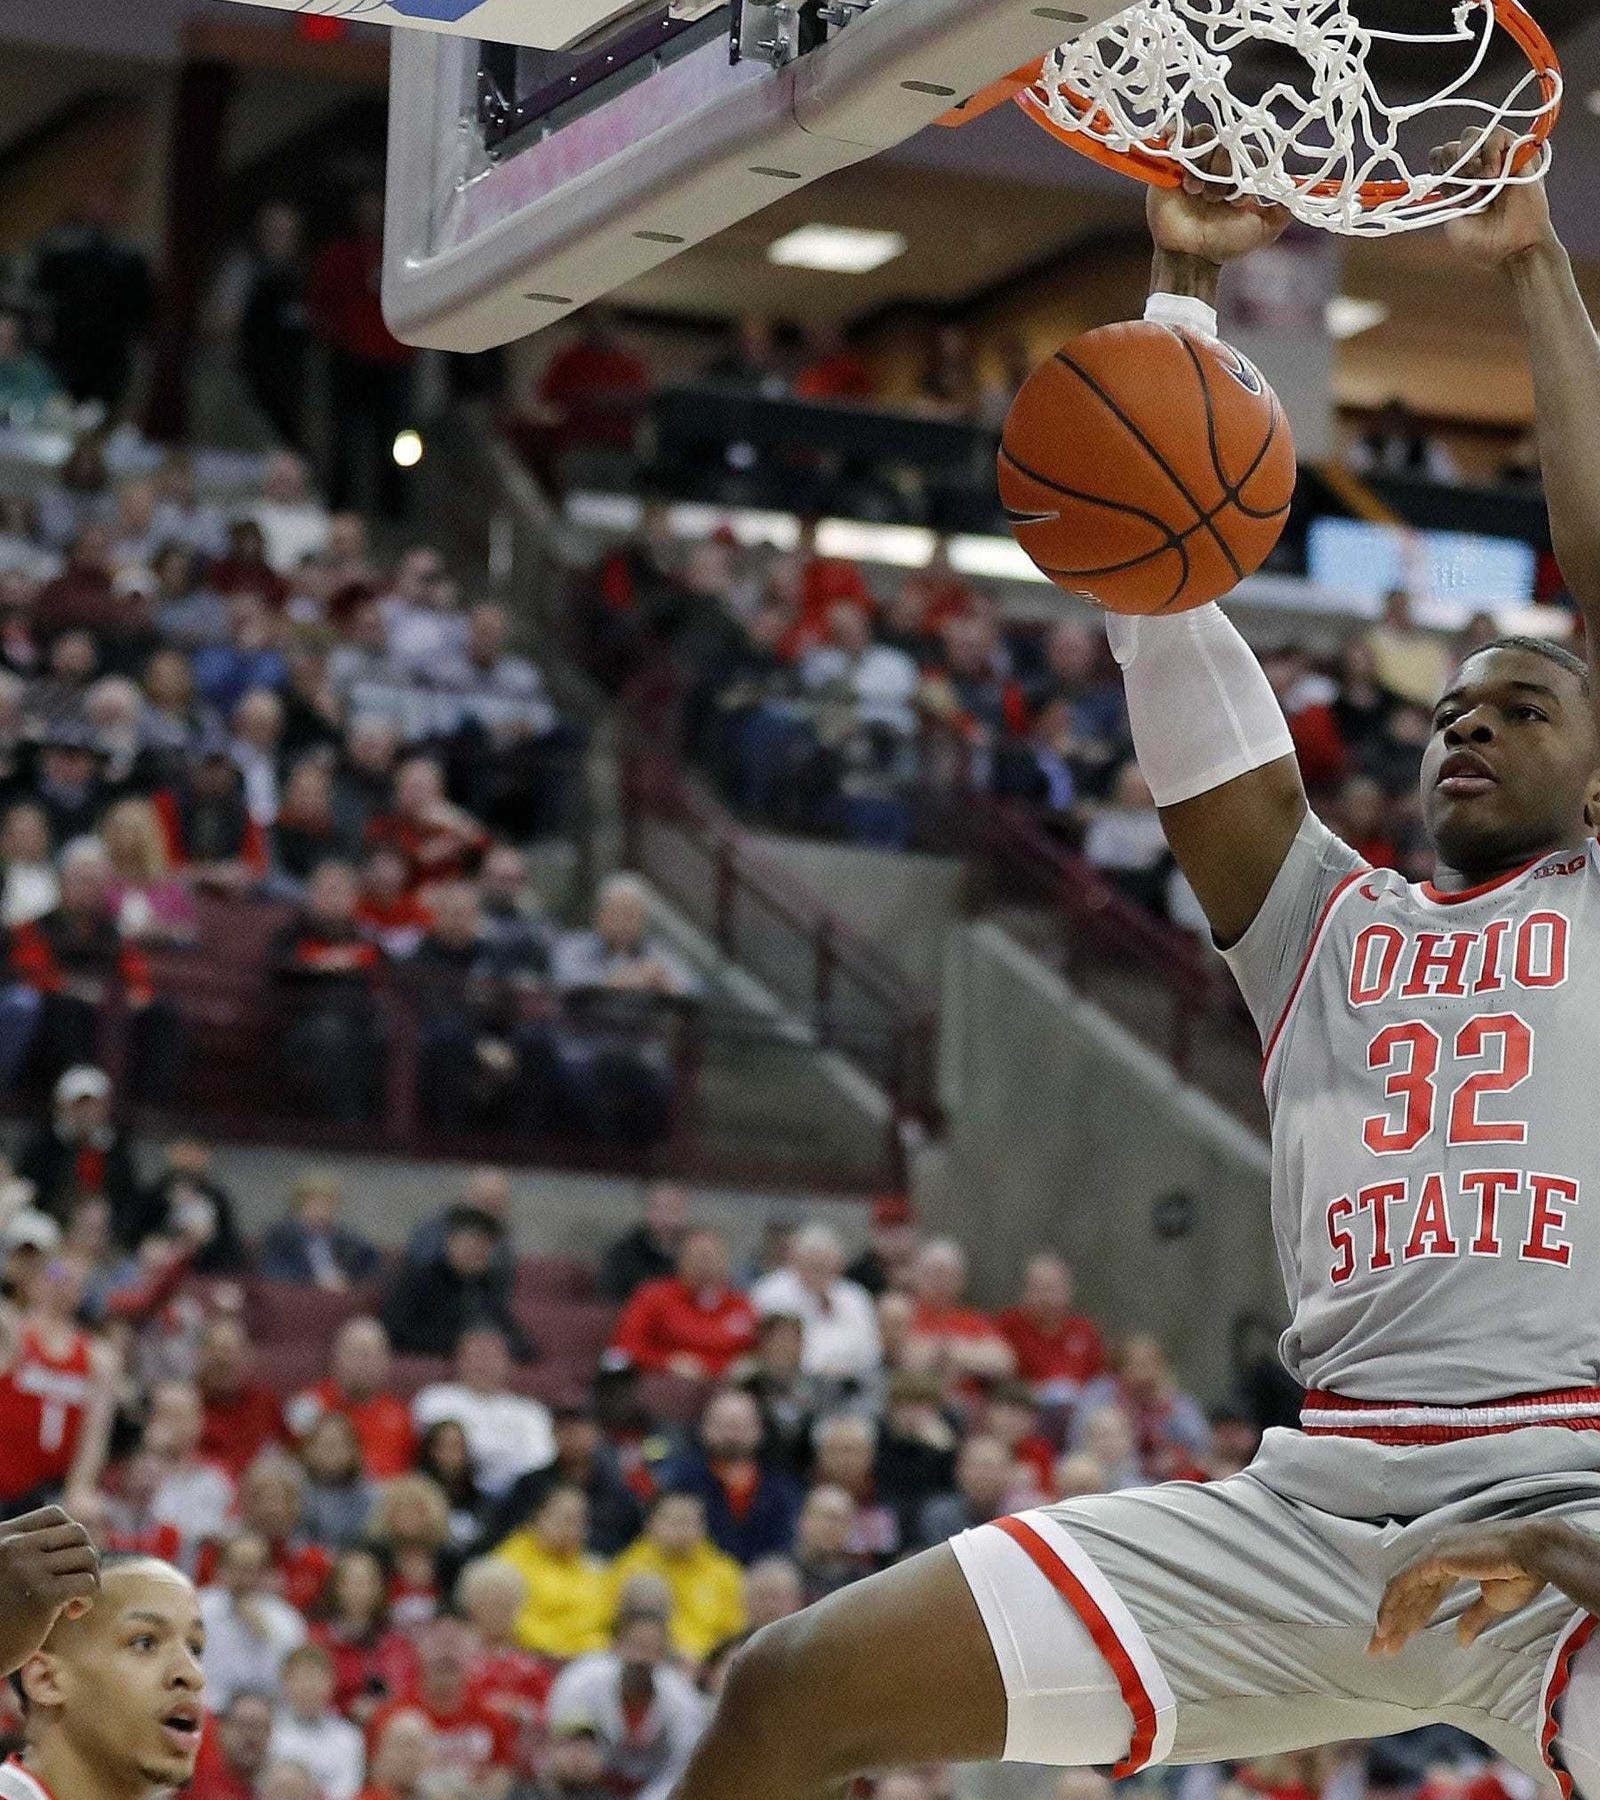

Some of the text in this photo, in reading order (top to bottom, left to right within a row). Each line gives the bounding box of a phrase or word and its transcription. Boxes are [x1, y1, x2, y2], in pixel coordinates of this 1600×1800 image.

[1349, 910, 1570, 1009] OHIO
[1361, 1011, 1535, 1157] 32
[1327, 1168, 1580, 1287] STATE
